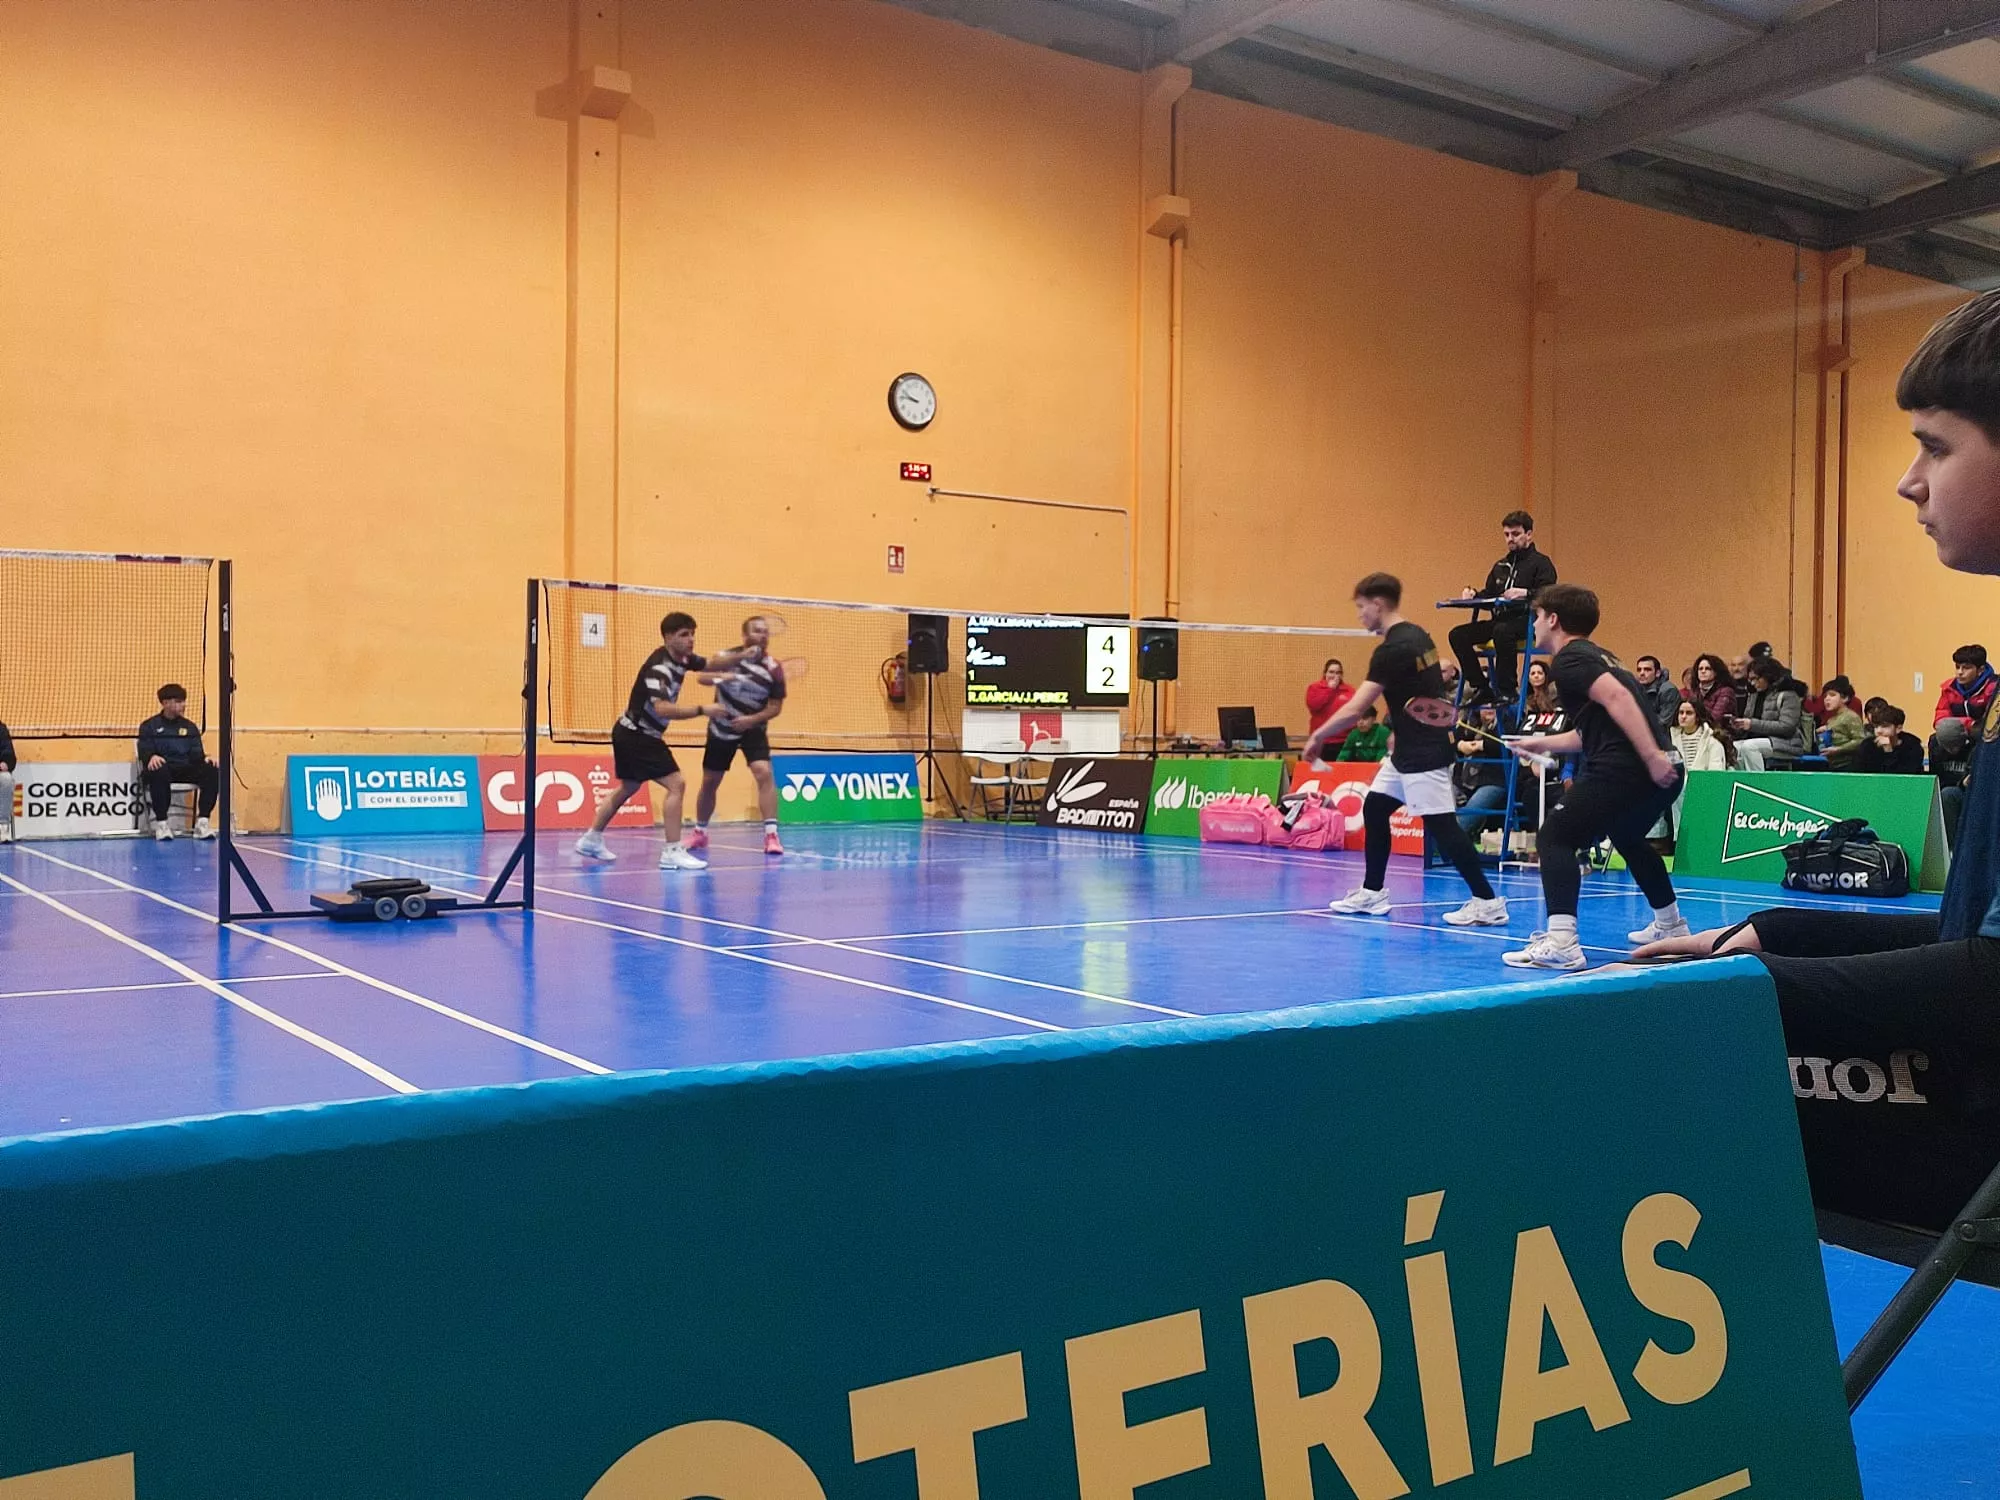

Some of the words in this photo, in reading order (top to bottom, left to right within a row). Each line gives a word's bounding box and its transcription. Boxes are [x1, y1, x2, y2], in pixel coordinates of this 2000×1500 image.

[589, 623, 598, 635] 4
[1102, 635, 1115, 655] 4
[1102, 666, 1115, 687] 2
[355, 766, 467, 789] LOTERÍAS
[830, 772, 912, 801] YONEX
[28, 802, 58, 817] DE
[65, 801, 147, 817] ARAGO
[369, 796, 393, 804] CON
[395, 796, 408, 804] EL
[410, 795, 456, 804] DEPORTE
[1734, 811, 1748, 829] El
[1747, 813, 1780, 831] Corte
